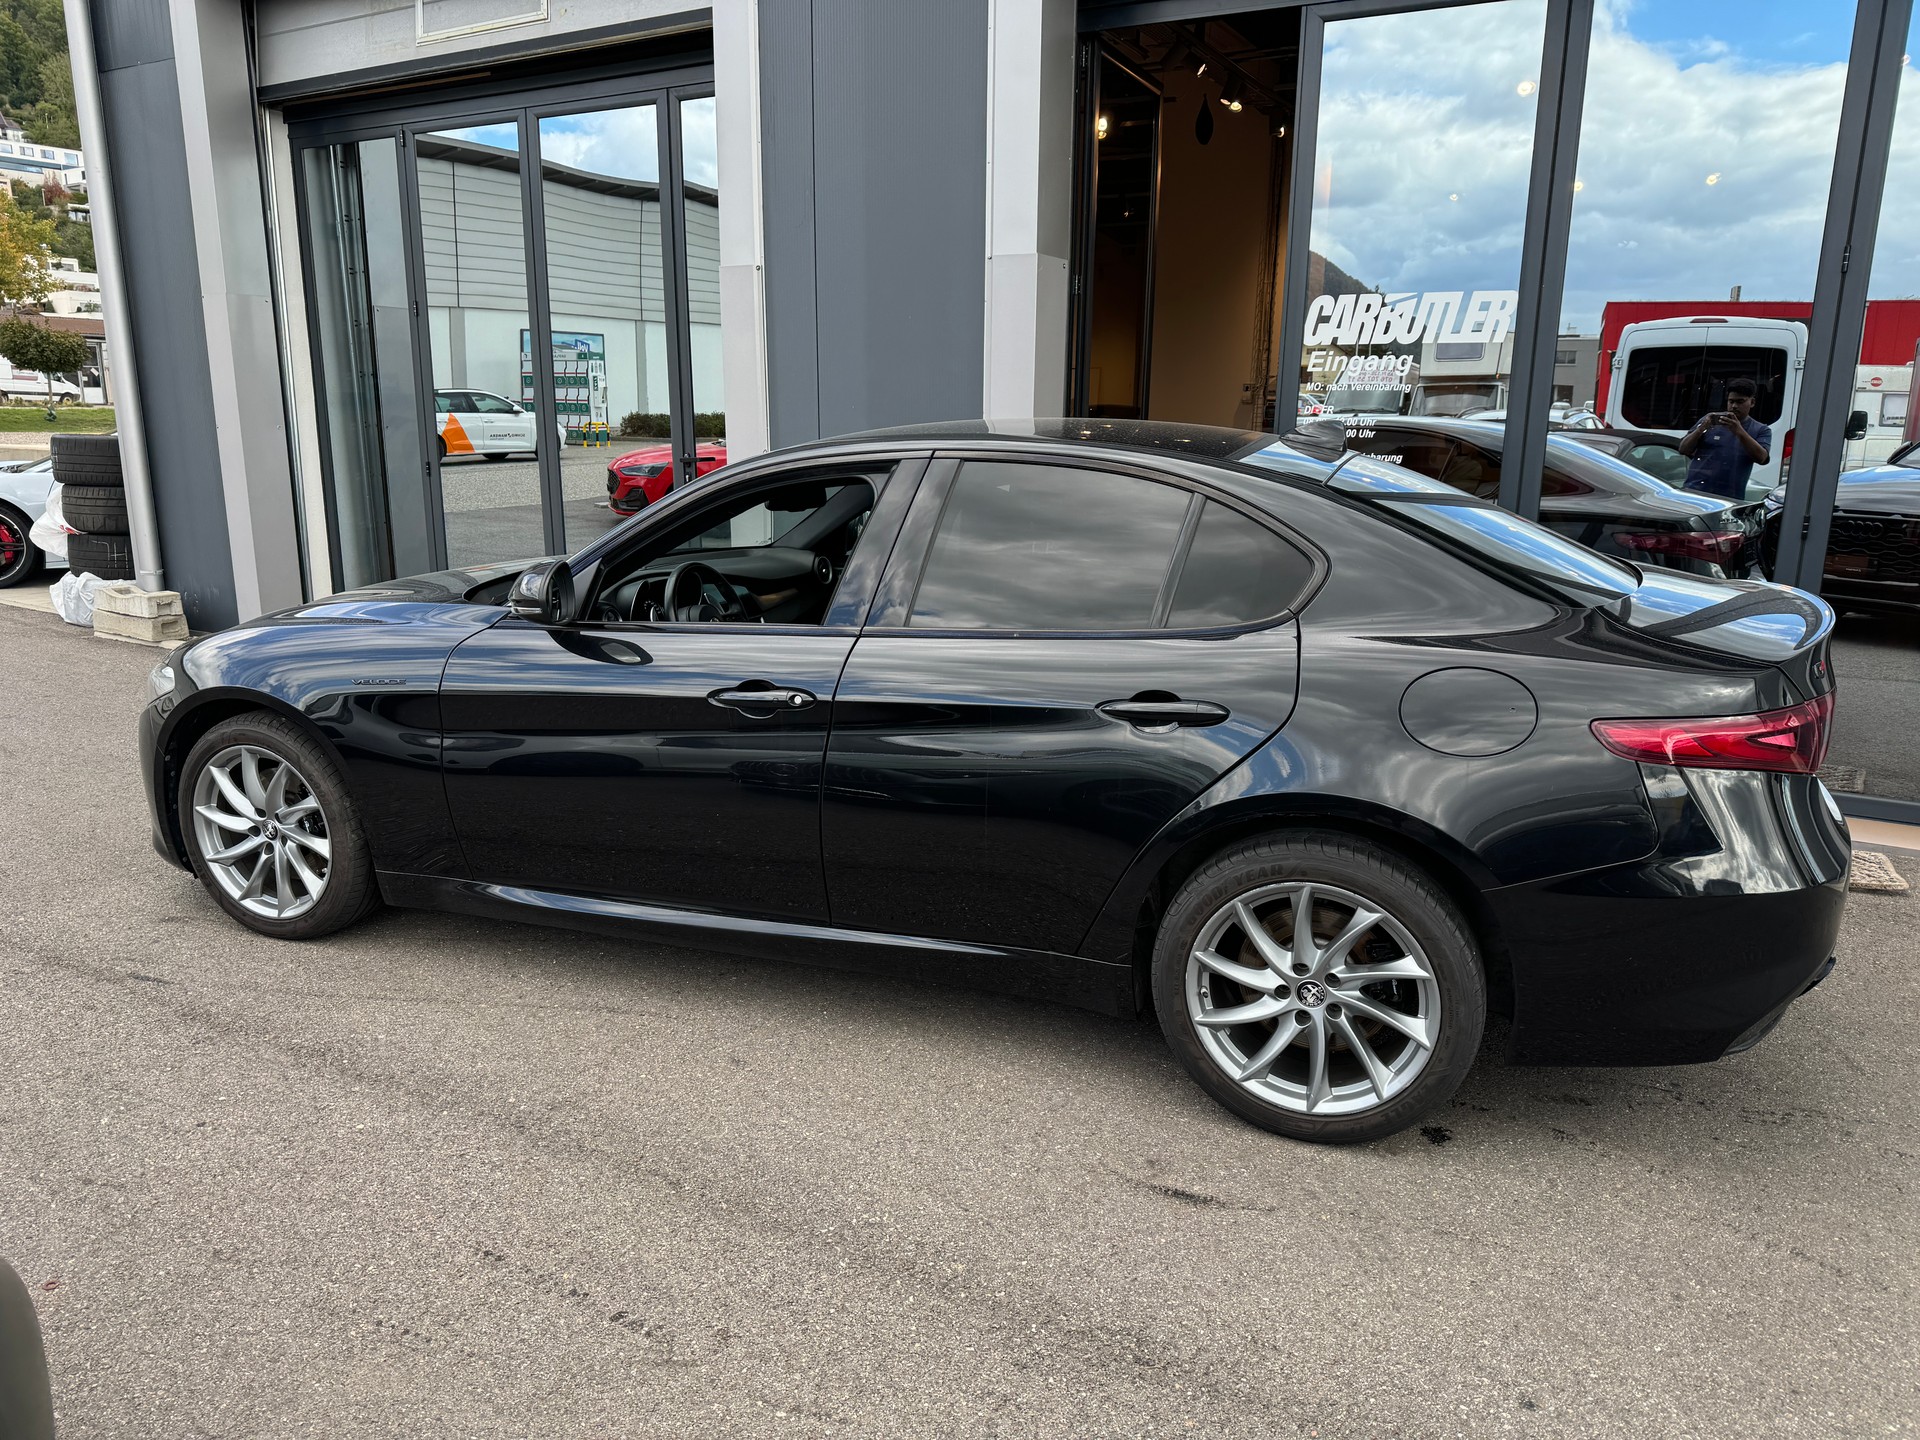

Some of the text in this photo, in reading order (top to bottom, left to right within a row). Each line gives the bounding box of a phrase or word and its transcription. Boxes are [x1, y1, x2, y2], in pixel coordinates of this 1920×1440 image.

[1303, 290, 1518, 346] CARBUTLER
[1306, 351, 1414, 376] Eingang
[1306, 382, 1411, 393] MO: nach Vereinbarung
[1321, 405, 1334, 414] FR
[1359, 418, 1377, 427] Uhr
[1358, 429, 1376, 438] Uhr
